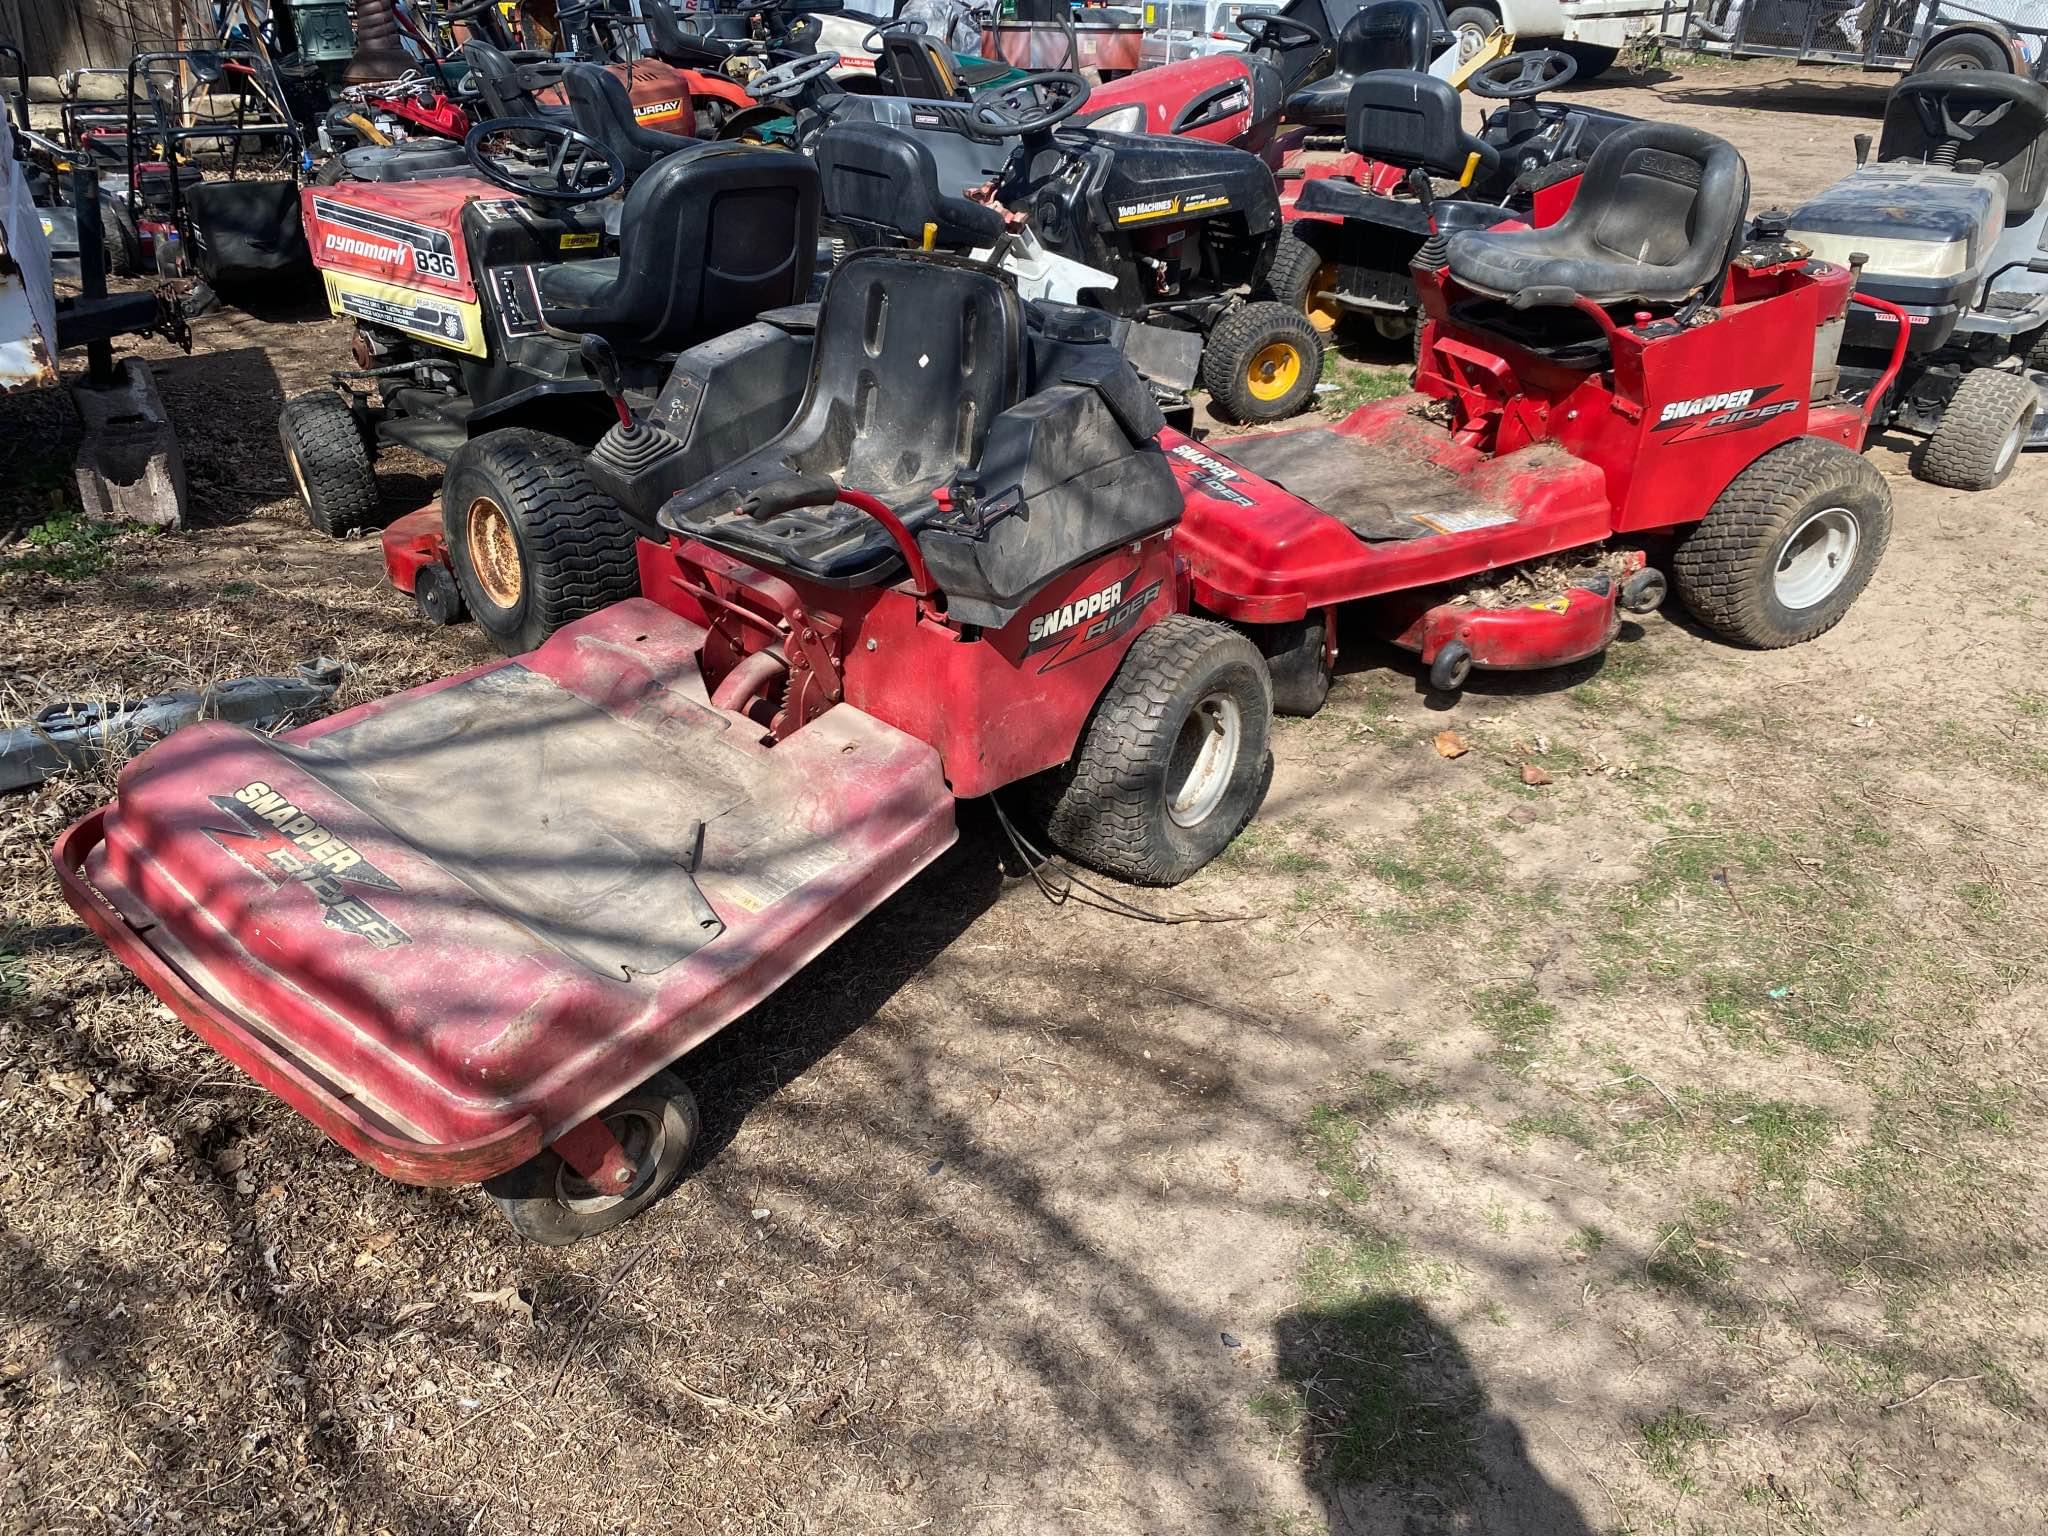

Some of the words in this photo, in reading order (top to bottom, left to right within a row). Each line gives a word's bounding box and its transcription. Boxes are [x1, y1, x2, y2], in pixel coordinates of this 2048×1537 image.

[1118, 205, 1137, 217] YARD
[1137, 199, 1172, 215] MACHINES
[416, 250, 456, 277] 836
[1660, 388, 1754, 422] SNAPPER
[1706, 401, 1800, 427] RIDER
[1171, 444, 1238, 480] SNAPPER
[1187, 470, 1255, 507] RIDER
[1028, 581, 1122, 643] SNAPPER
[1085, 585, 1161, 641] RIDER
[233, 781, 363, 874] SNAPPER
